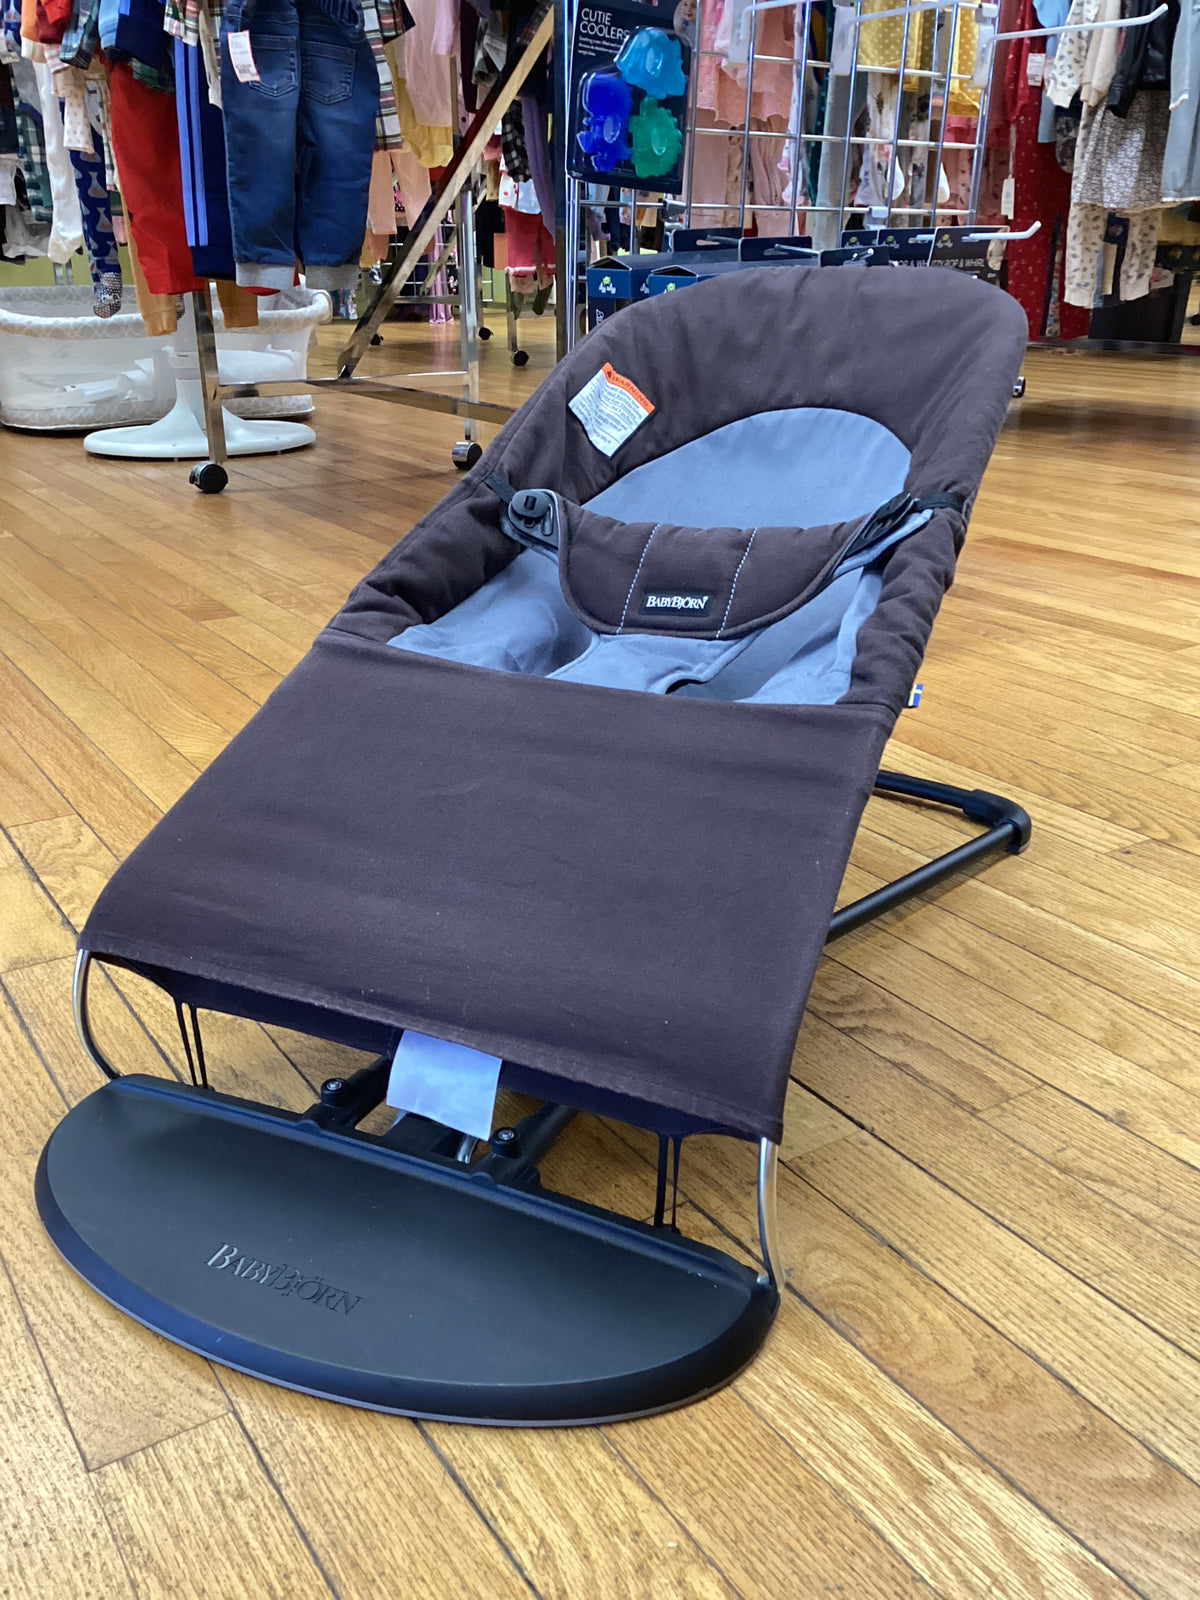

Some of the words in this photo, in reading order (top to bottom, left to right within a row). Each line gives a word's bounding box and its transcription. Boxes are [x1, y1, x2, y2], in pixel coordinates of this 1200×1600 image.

[581, 8, 612, 25] CUTIE
[579, 21, 631, 41] COOLERS
[612, 375, 649, 407] WARNING
[646, 595, 709, 610] BABYBJÖRN
[204, 1242, 363, 1316] BABYBJÖRN
